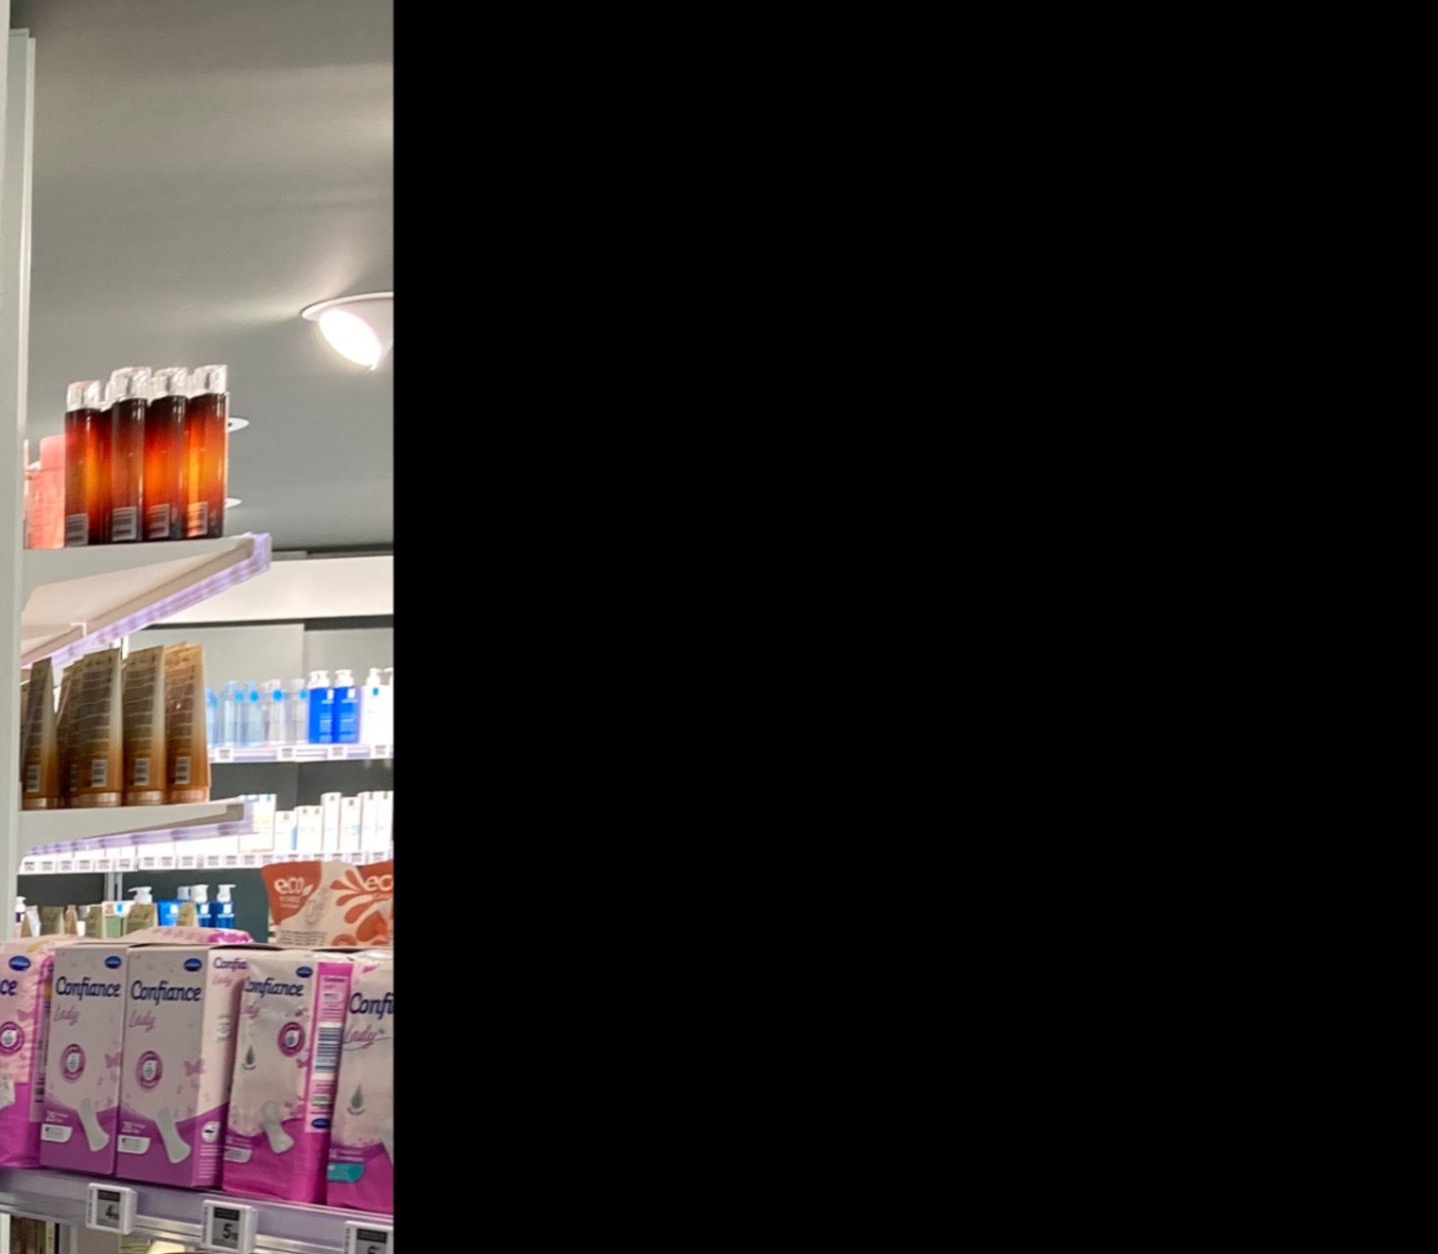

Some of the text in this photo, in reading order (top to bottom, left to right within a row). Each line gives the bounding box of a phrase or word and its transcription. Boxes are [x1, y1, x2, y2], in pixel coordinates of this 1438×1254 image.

[274, 876, 303, 896] eco
[363, 874, 394, 892] ec
[213, 957, 247, 970] Confia
[55, 976, 122, 1001] Confiance
[130, 980, 202, 1006] Confiance
[53, 1004, 81, 1026] Lady
[349, 992, 394, 1020] Confi
[128, 1009, 157, 1031] Lady
[344, 1023, 379, 1048] Lady
